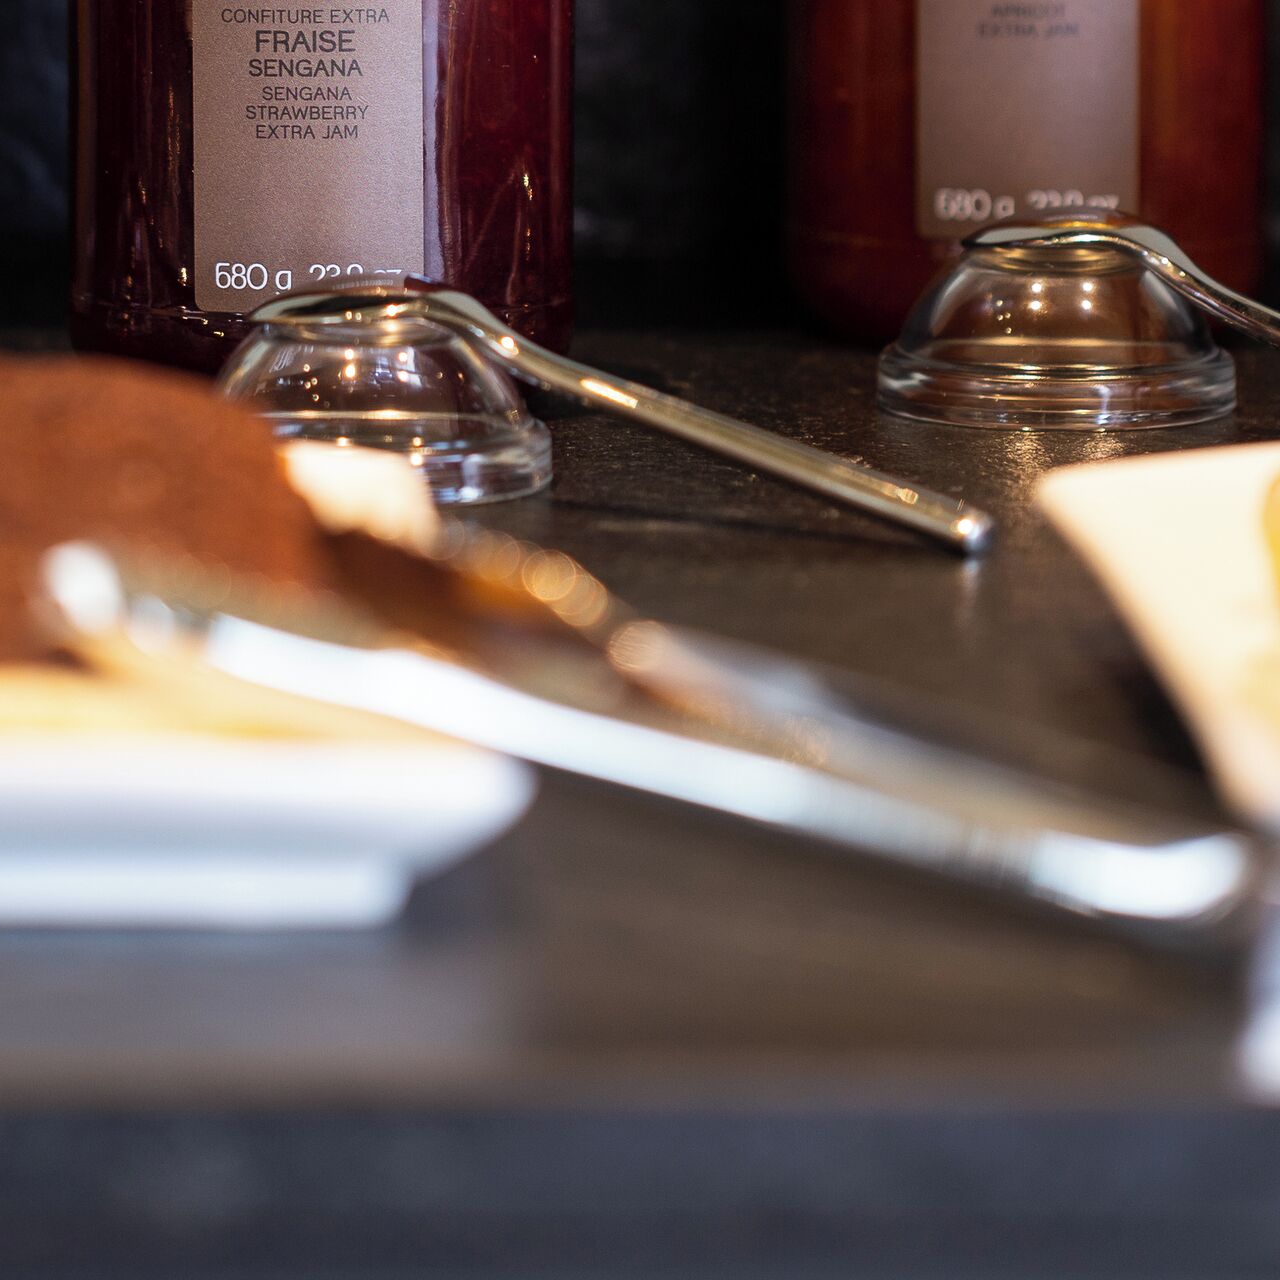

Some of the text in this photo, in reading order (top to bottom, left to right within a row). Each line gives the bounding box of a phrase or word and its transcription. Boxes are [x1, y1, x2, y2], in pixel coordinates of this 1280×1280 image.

[221, 8, 390, 24] CONFITURE EXTRA
[254, 29, 356, 53] FRAISE
[248, 58, 364, 78] SENGANA
[261, 86, 353, 101] SENGANA
[245, 105, 369, 121] STRAWBERRY
[255, 124, 359, 140] EXTRA JAM
[215, 262, 269, 290] 680
